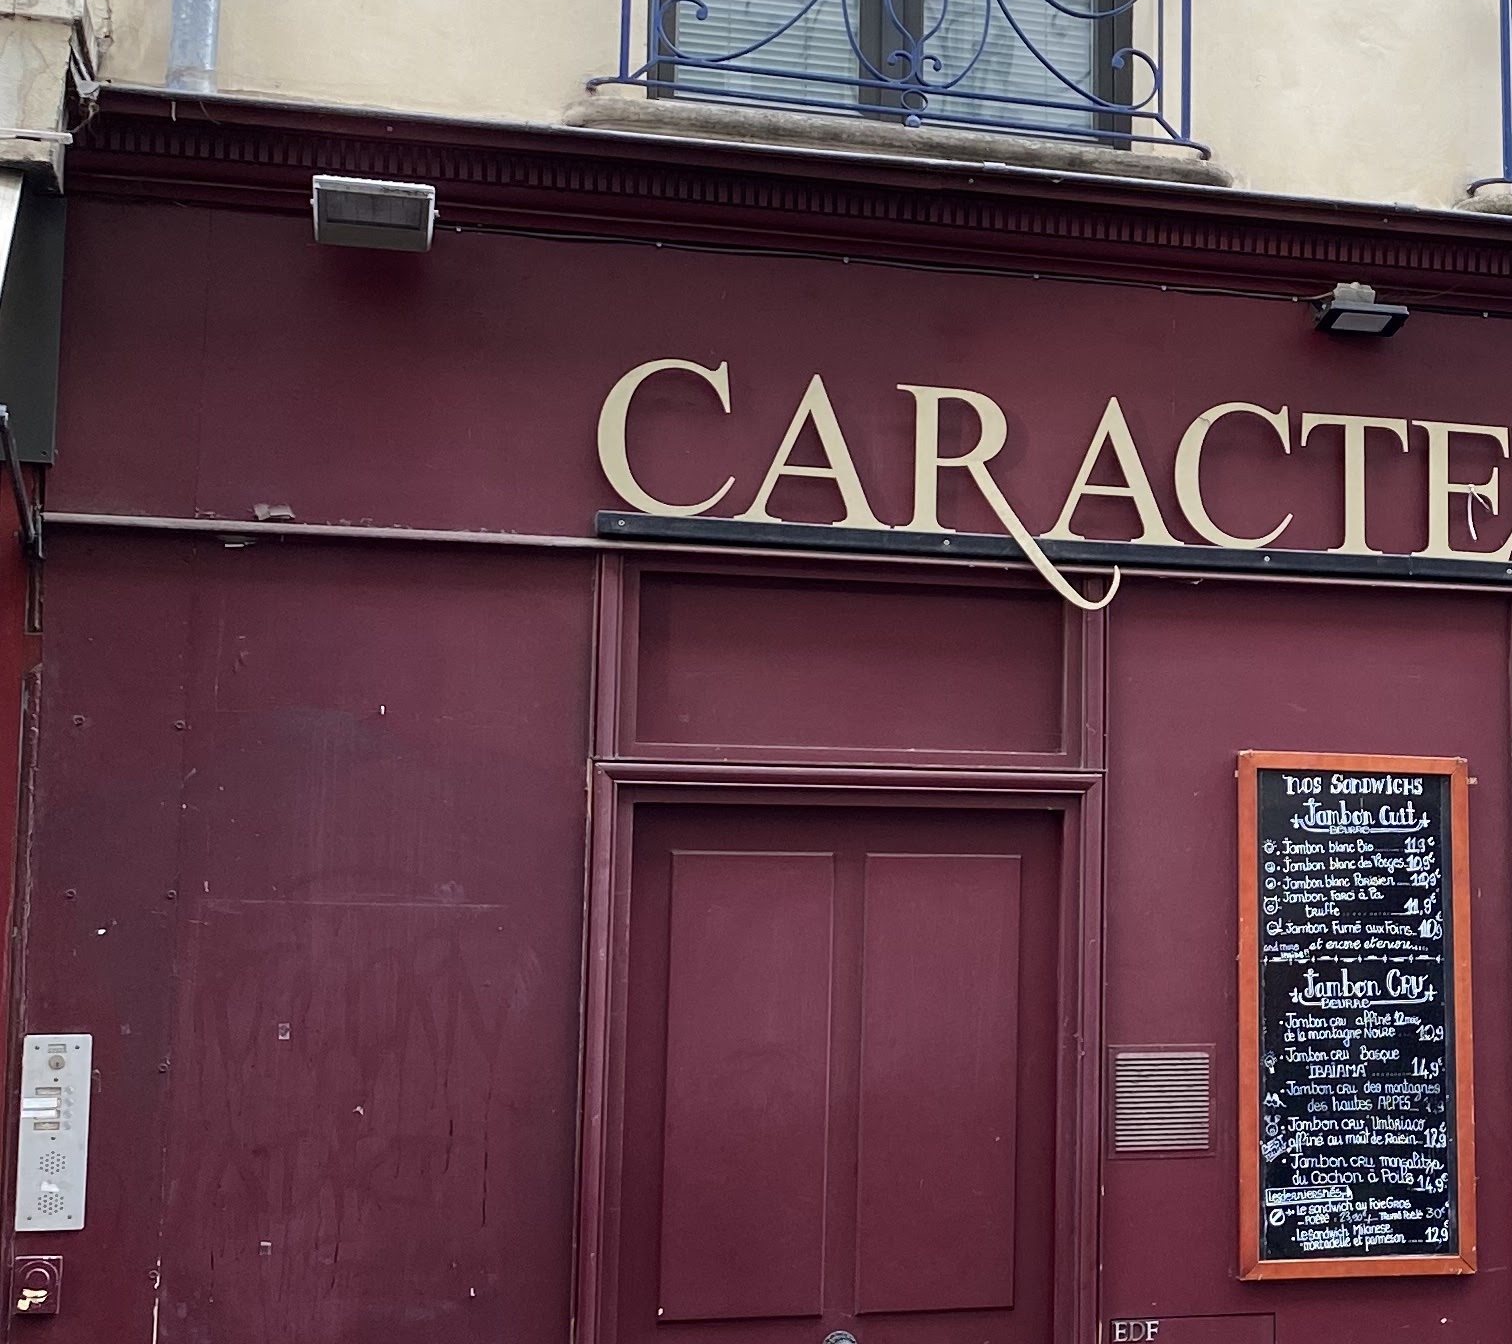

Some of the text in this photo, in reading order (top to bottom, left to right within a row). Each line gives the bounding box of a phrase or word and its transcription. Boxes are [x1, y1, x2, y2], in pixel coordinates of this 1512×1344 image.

[1303, 797, 1376, 826] Jambon
[1282, 837, 1325, 855] Jambon
[1329, 840, 1356, 853] blanc
[1357, 838, 1374, 852] Bio
[1282, 856, 1325, 873] Jambon
[1329, 856, 1356, 870] blanc
[1358, 855, 1372, 868] des
[1282, 875, 1324, 890] Jambon
[1325, 874, 1351, 888] blanc
[1282, 891, 1327, 903] Jambon
[1305, 902, 1341, 918] truffe
[1285, 920, 1328, 934] Jambon
[1303, 968, 1381, 998] Jambon
[1285, 1012, 1328, 1029] Jambon
[1308, 1026, 1362, 1047] montagne
[1285, 1046, 1329, 1062] Jambon
[1359, 1045, 1399, 1064] Basque
[1286, 1080, 1334, 1096] Jambon
[1364, 1080, 1381, 1094] des
[1385, 1078, 1441, 1101] montagnes
[1307, 1098, 1328, 1113] des
[1332, 1095, 1373, 1111] hautes
[1287, 1116, 1339, 1131] Jambon
[1290, 1153, 1348, 1170] Jambon
[1311, 1169, 1364, 1185] Cochon
[1112, 1320, 1159, 1342] EDF
